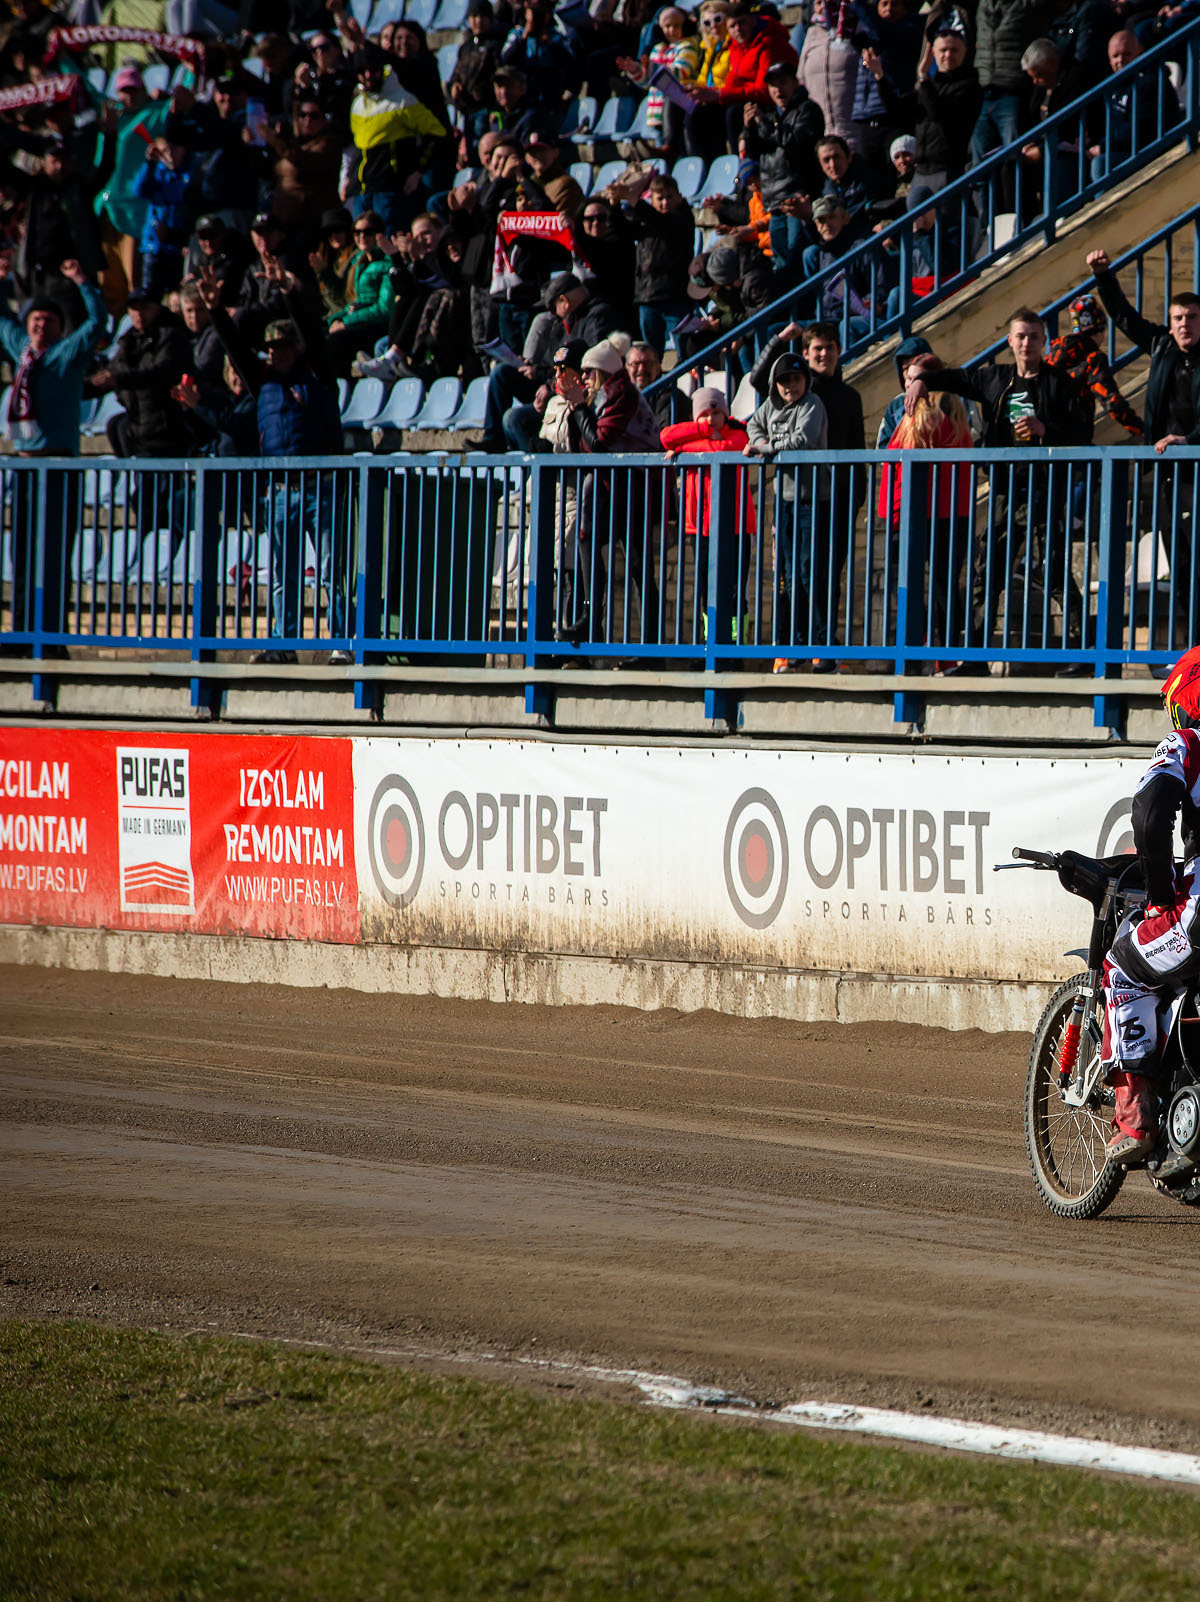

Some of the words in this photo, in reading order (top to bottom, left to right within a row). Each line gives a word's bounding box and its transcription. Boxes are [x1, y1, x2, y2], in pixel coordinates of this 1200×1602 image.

[0, 73, 70, 103] MOTIV
[121, 757, 185, 798] PUFAS
[240, 769, 324, 810] IZCILAM
[122, 818, 141, 834] MADE
[144, 819, 150, 834] IN
[154, 820, 186, 836] GERMANY
[438, 790, 609, 877] OPTIBET
[223, 824, 344, 867] REMONTAM
[804, 805, 991, 894] OPTIBET
[225, 875, 344, 908] WWW.PUFAS.LV
[440, 880, 530, 902] SPORTA
[548, 883, 609, 907] BĀRS
[805, 900, 907, 922] SPORTA
[927, 902, 992, 926] BĀRS
[1126, 1039, 1152, 1052] Systems
